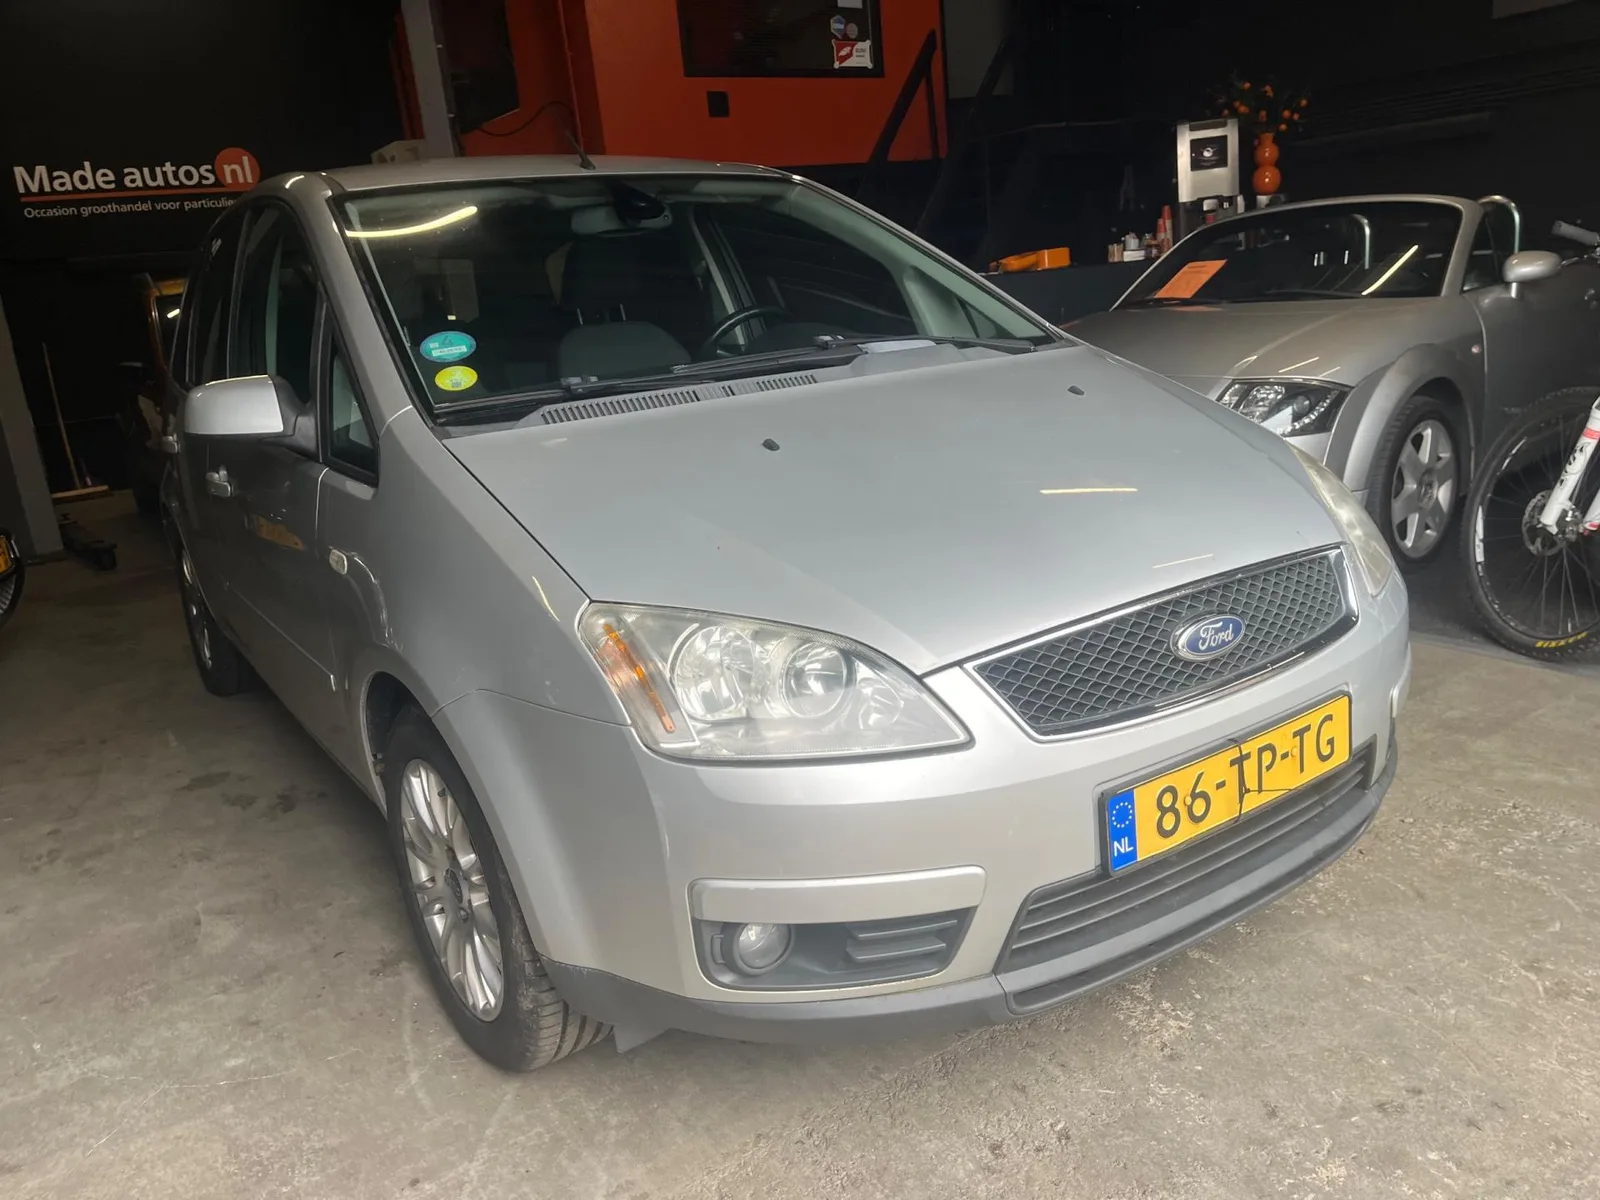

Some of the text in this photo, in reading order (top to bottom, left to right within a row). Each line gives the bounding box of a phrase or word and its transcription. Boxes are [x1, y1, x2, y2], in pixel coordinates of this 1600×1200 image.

[13, 156, 253, 193] Made autos nl
[24, 196, 237, 218] Occasion groothandel voor particulie
[1198, 621, 1234, 650] Ford
[1156, 714, 1335, 838] 86-TP-TG
[1113, 836, 1134, 857] NL
